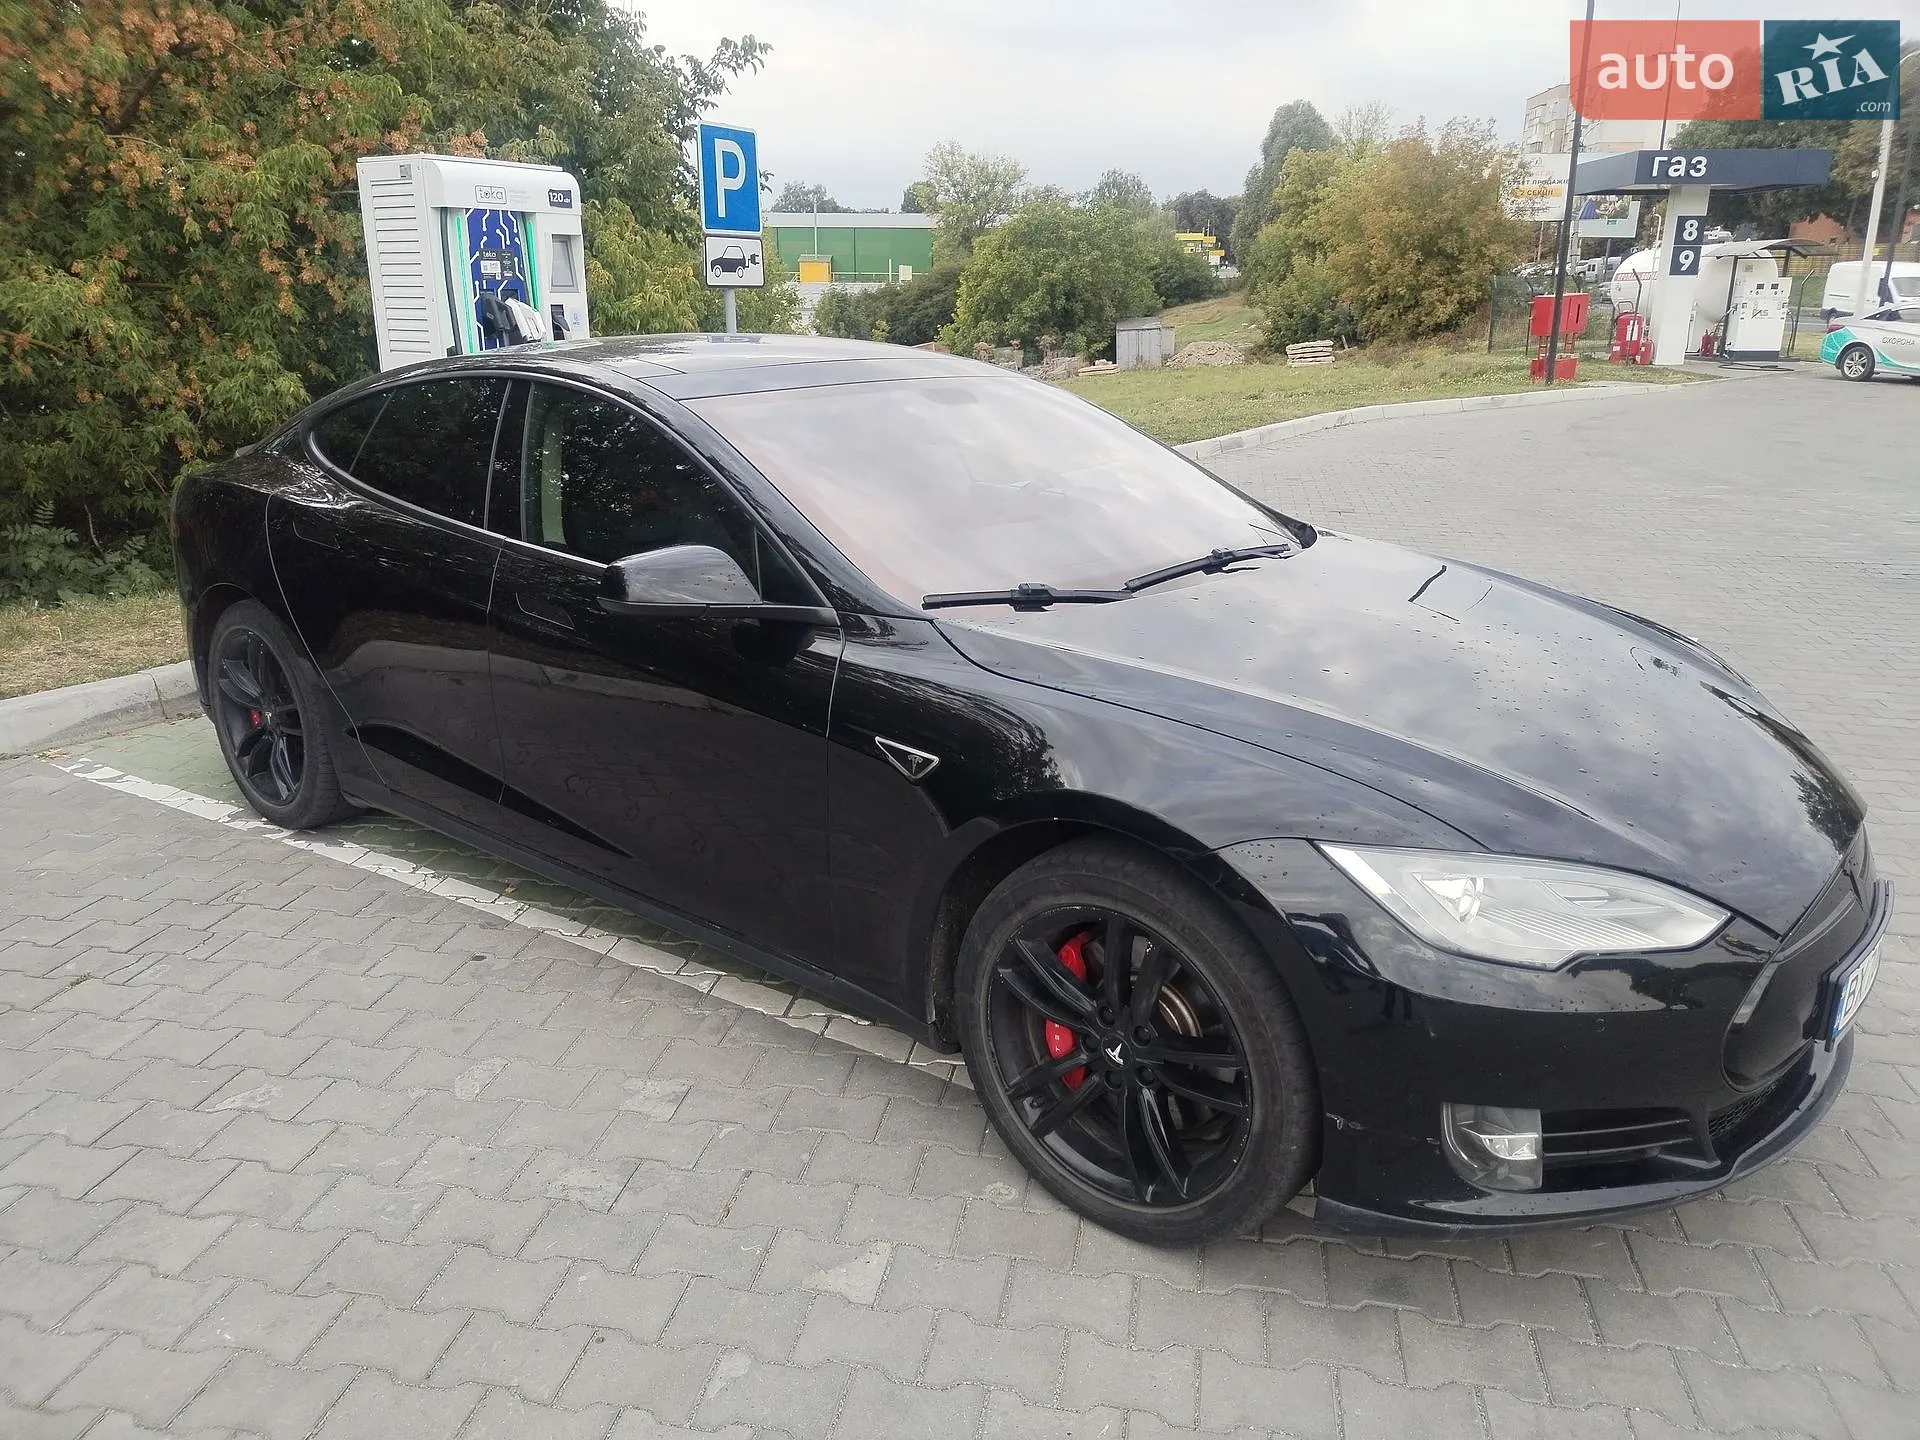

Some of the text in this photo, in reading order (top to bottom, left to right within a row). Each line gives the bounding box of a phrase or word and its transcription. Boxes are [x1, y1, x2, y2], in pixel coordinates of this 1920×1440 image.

[714, 138, 746, 217] P
[1651, 156, 1708, 177] газ
[549, 193, 564, 203] 120
[1682, 219, 1699, 241] 8
[1679, 249, 1695, 271] 9
